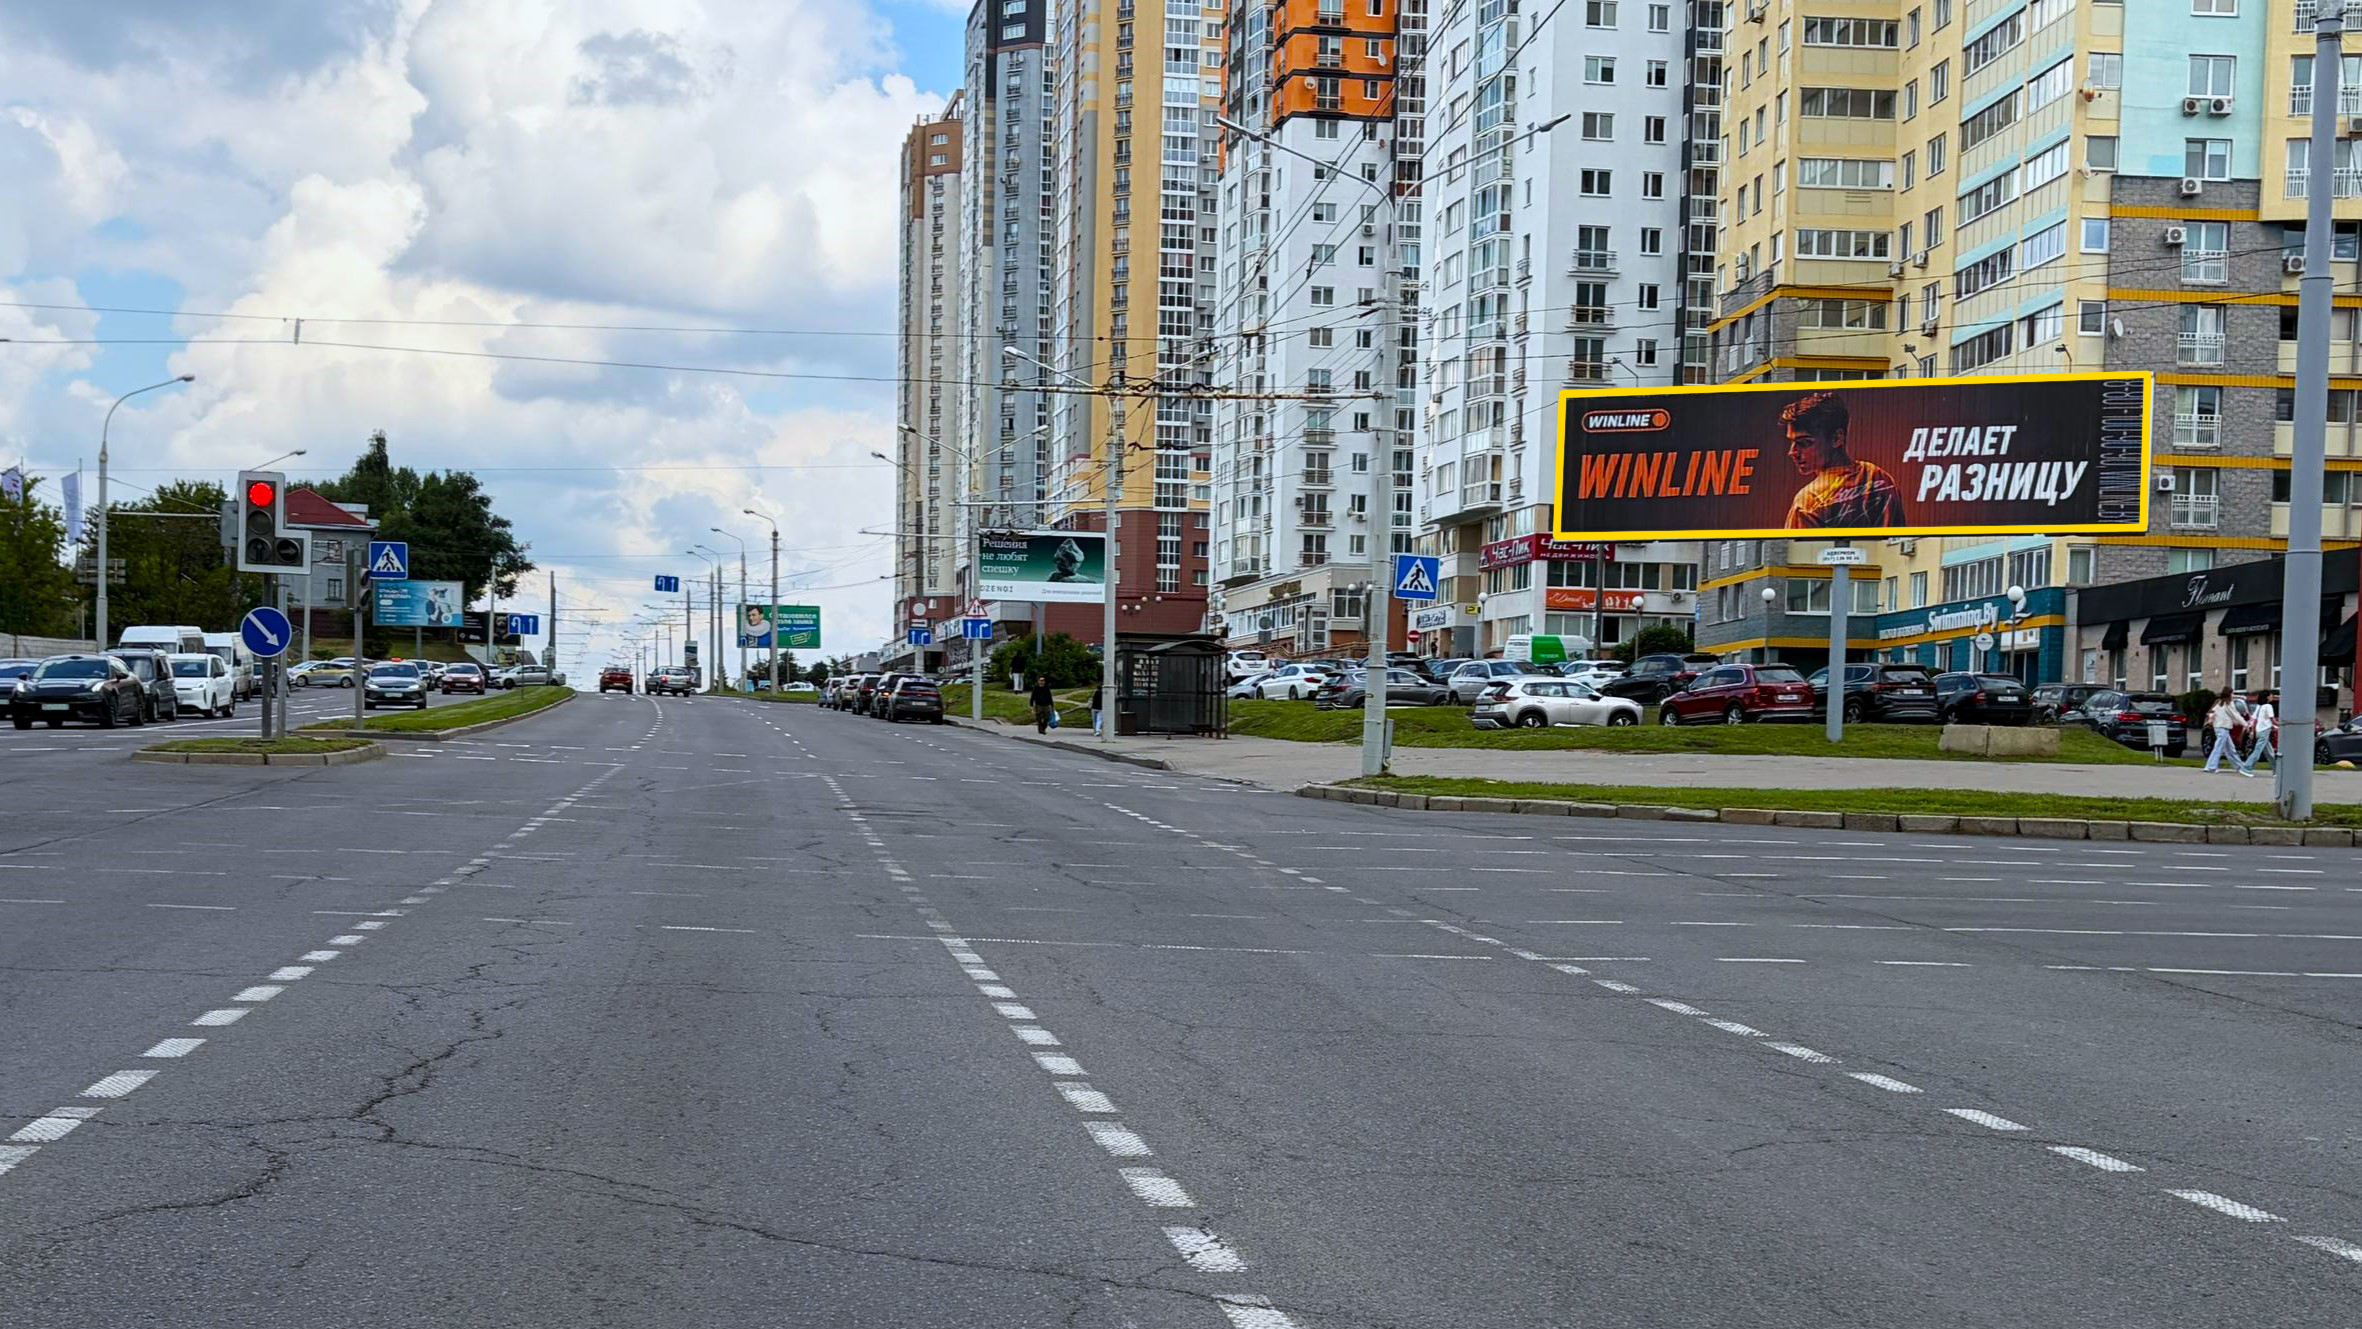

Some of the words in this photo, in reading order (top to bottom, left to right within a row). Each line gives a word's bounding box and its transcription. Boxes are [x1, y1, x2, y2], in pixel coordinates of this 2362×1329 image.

[1588, 414, 1651, 428] WINLINE
[1902, 425, 2017, 463] ДЕЛАЕТ
[1578, 448, 1760, 499] WINLINE
[1916, 461, 2089, 506] РАЗНИЦУ
[982, 537, 1028, 549] Решения
[1492, 541, 1531, 562] Час-Пик
[996, 551, 1029, 562] любят
[981, 565, 1020, 577] спешку
[1927, 602, 2000, 632] Swimming.By
